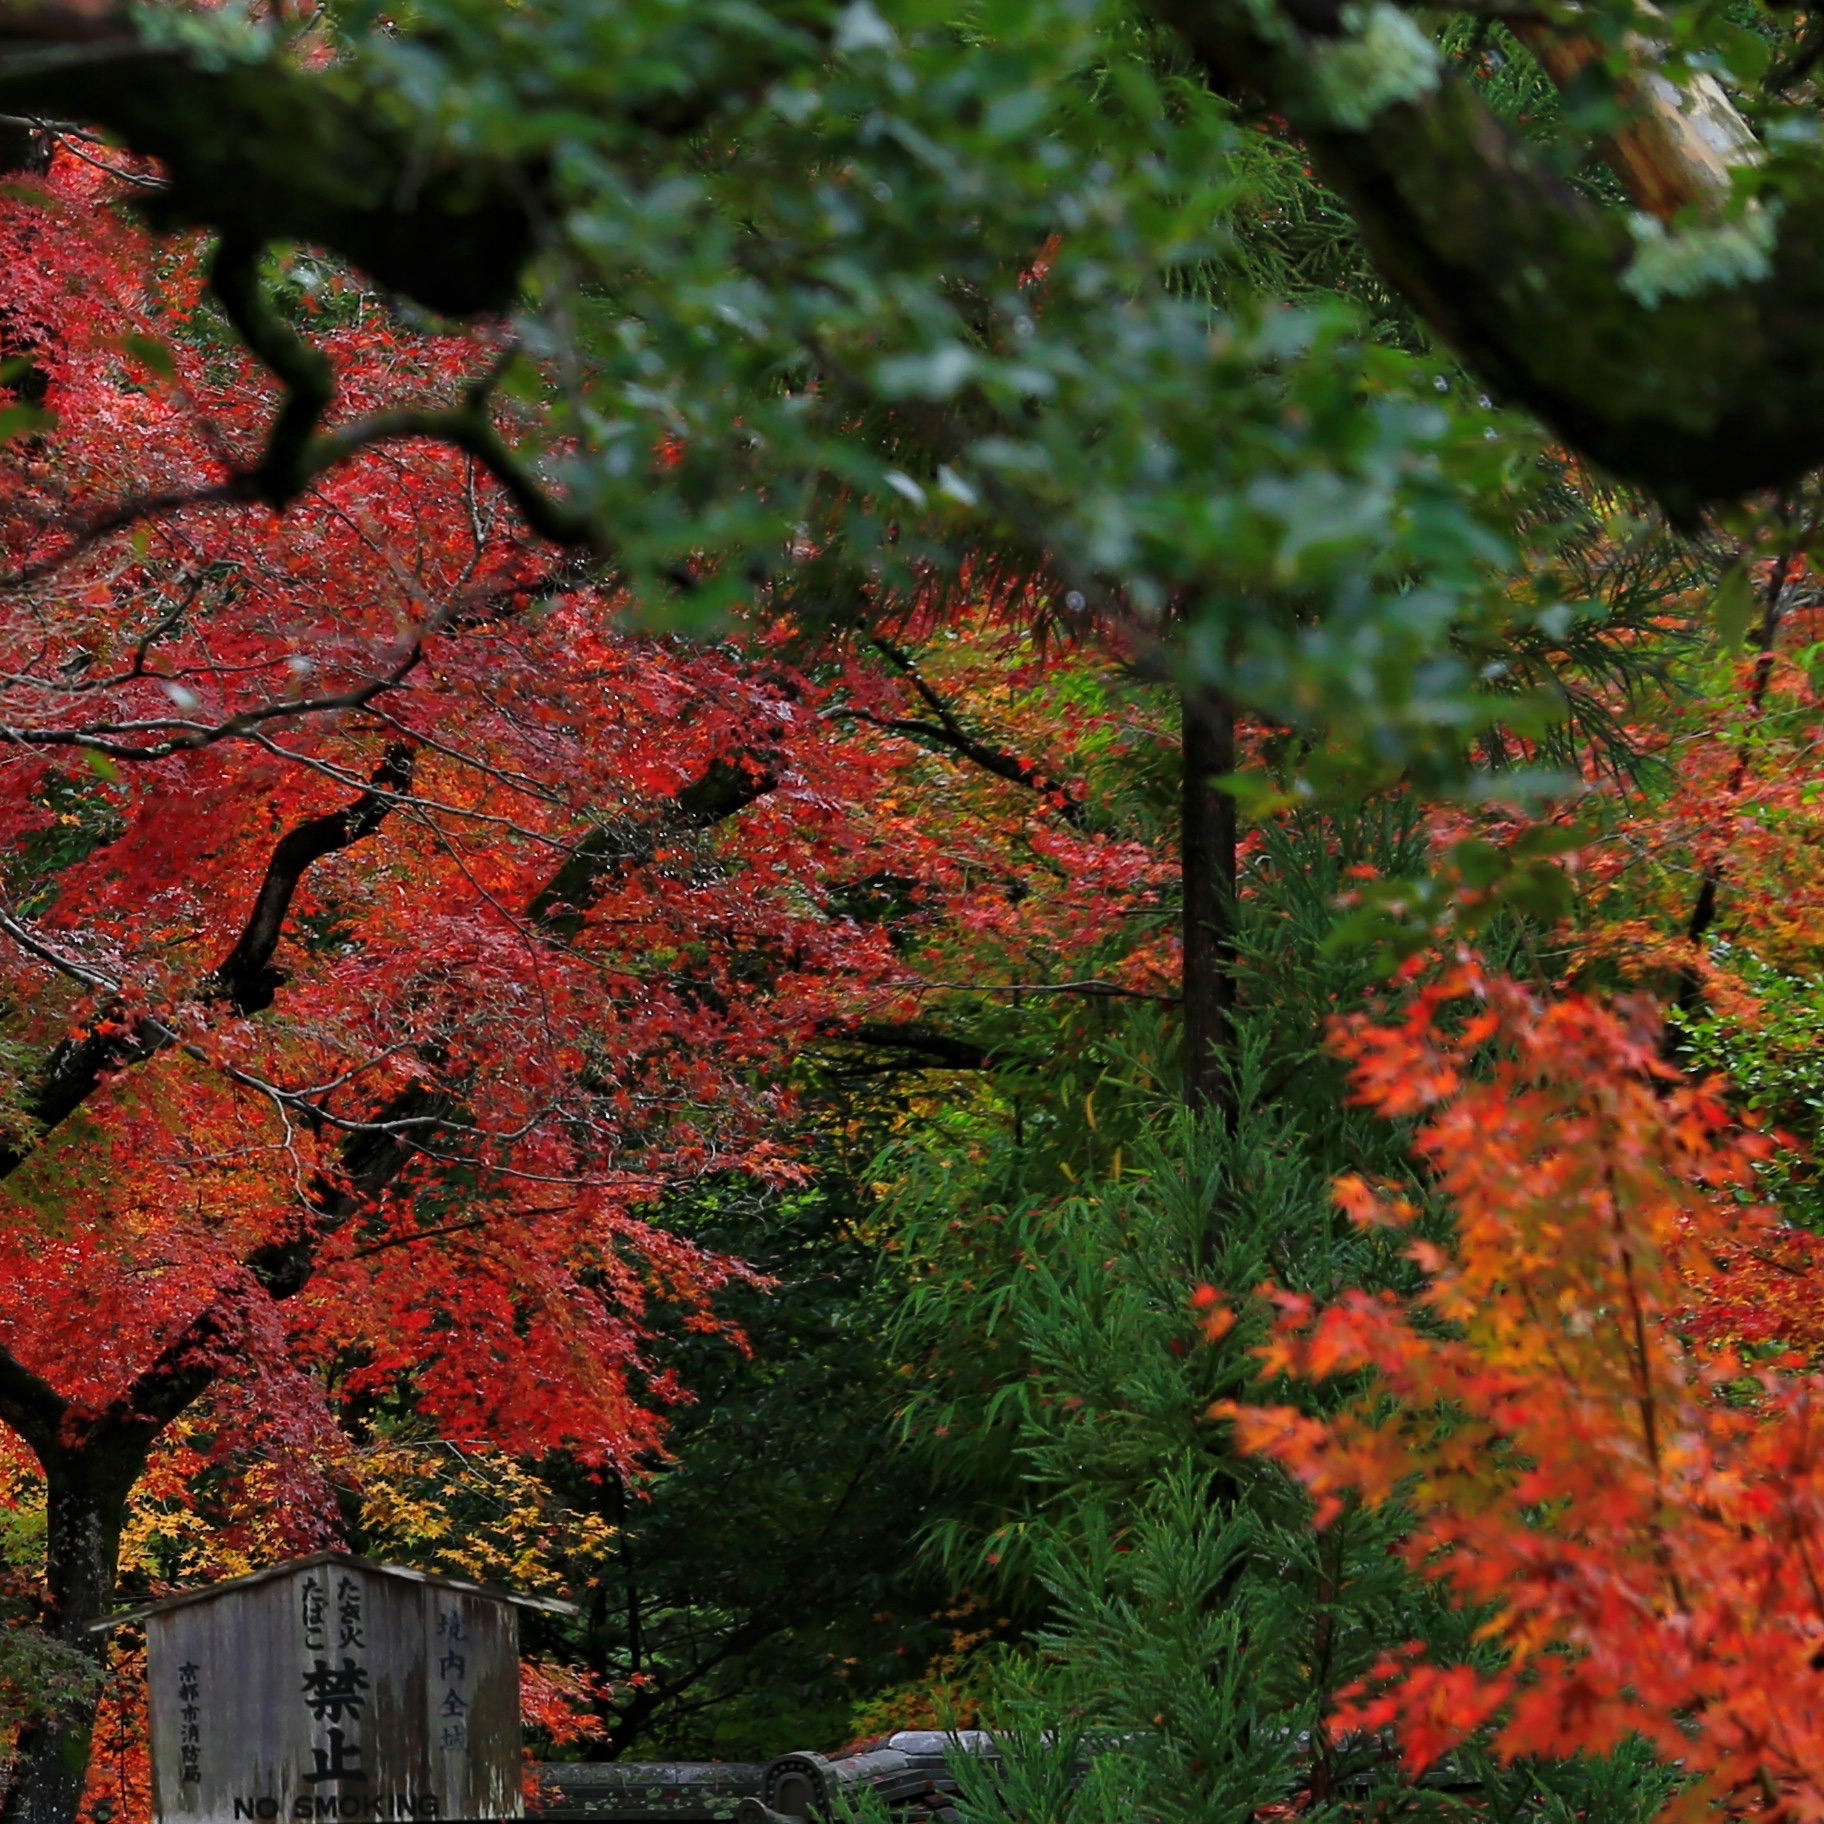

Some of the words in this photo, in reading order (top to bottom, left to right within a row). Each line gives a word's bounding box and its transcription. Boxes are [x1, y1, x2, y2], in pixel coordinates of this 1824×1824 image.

[301, 1576, 328, 1651] たばこ
[337, 1577, 365, 1649] たき火
[177, 1661, 202, 1784] 京都市消防局
[301, 1657, 370, 1784] 禁止
[438, 1611, 468, 1752] 境内全域
[234, 1796, 278, 1820] NO
[293, 1793, 439, 1819] SMOKING
